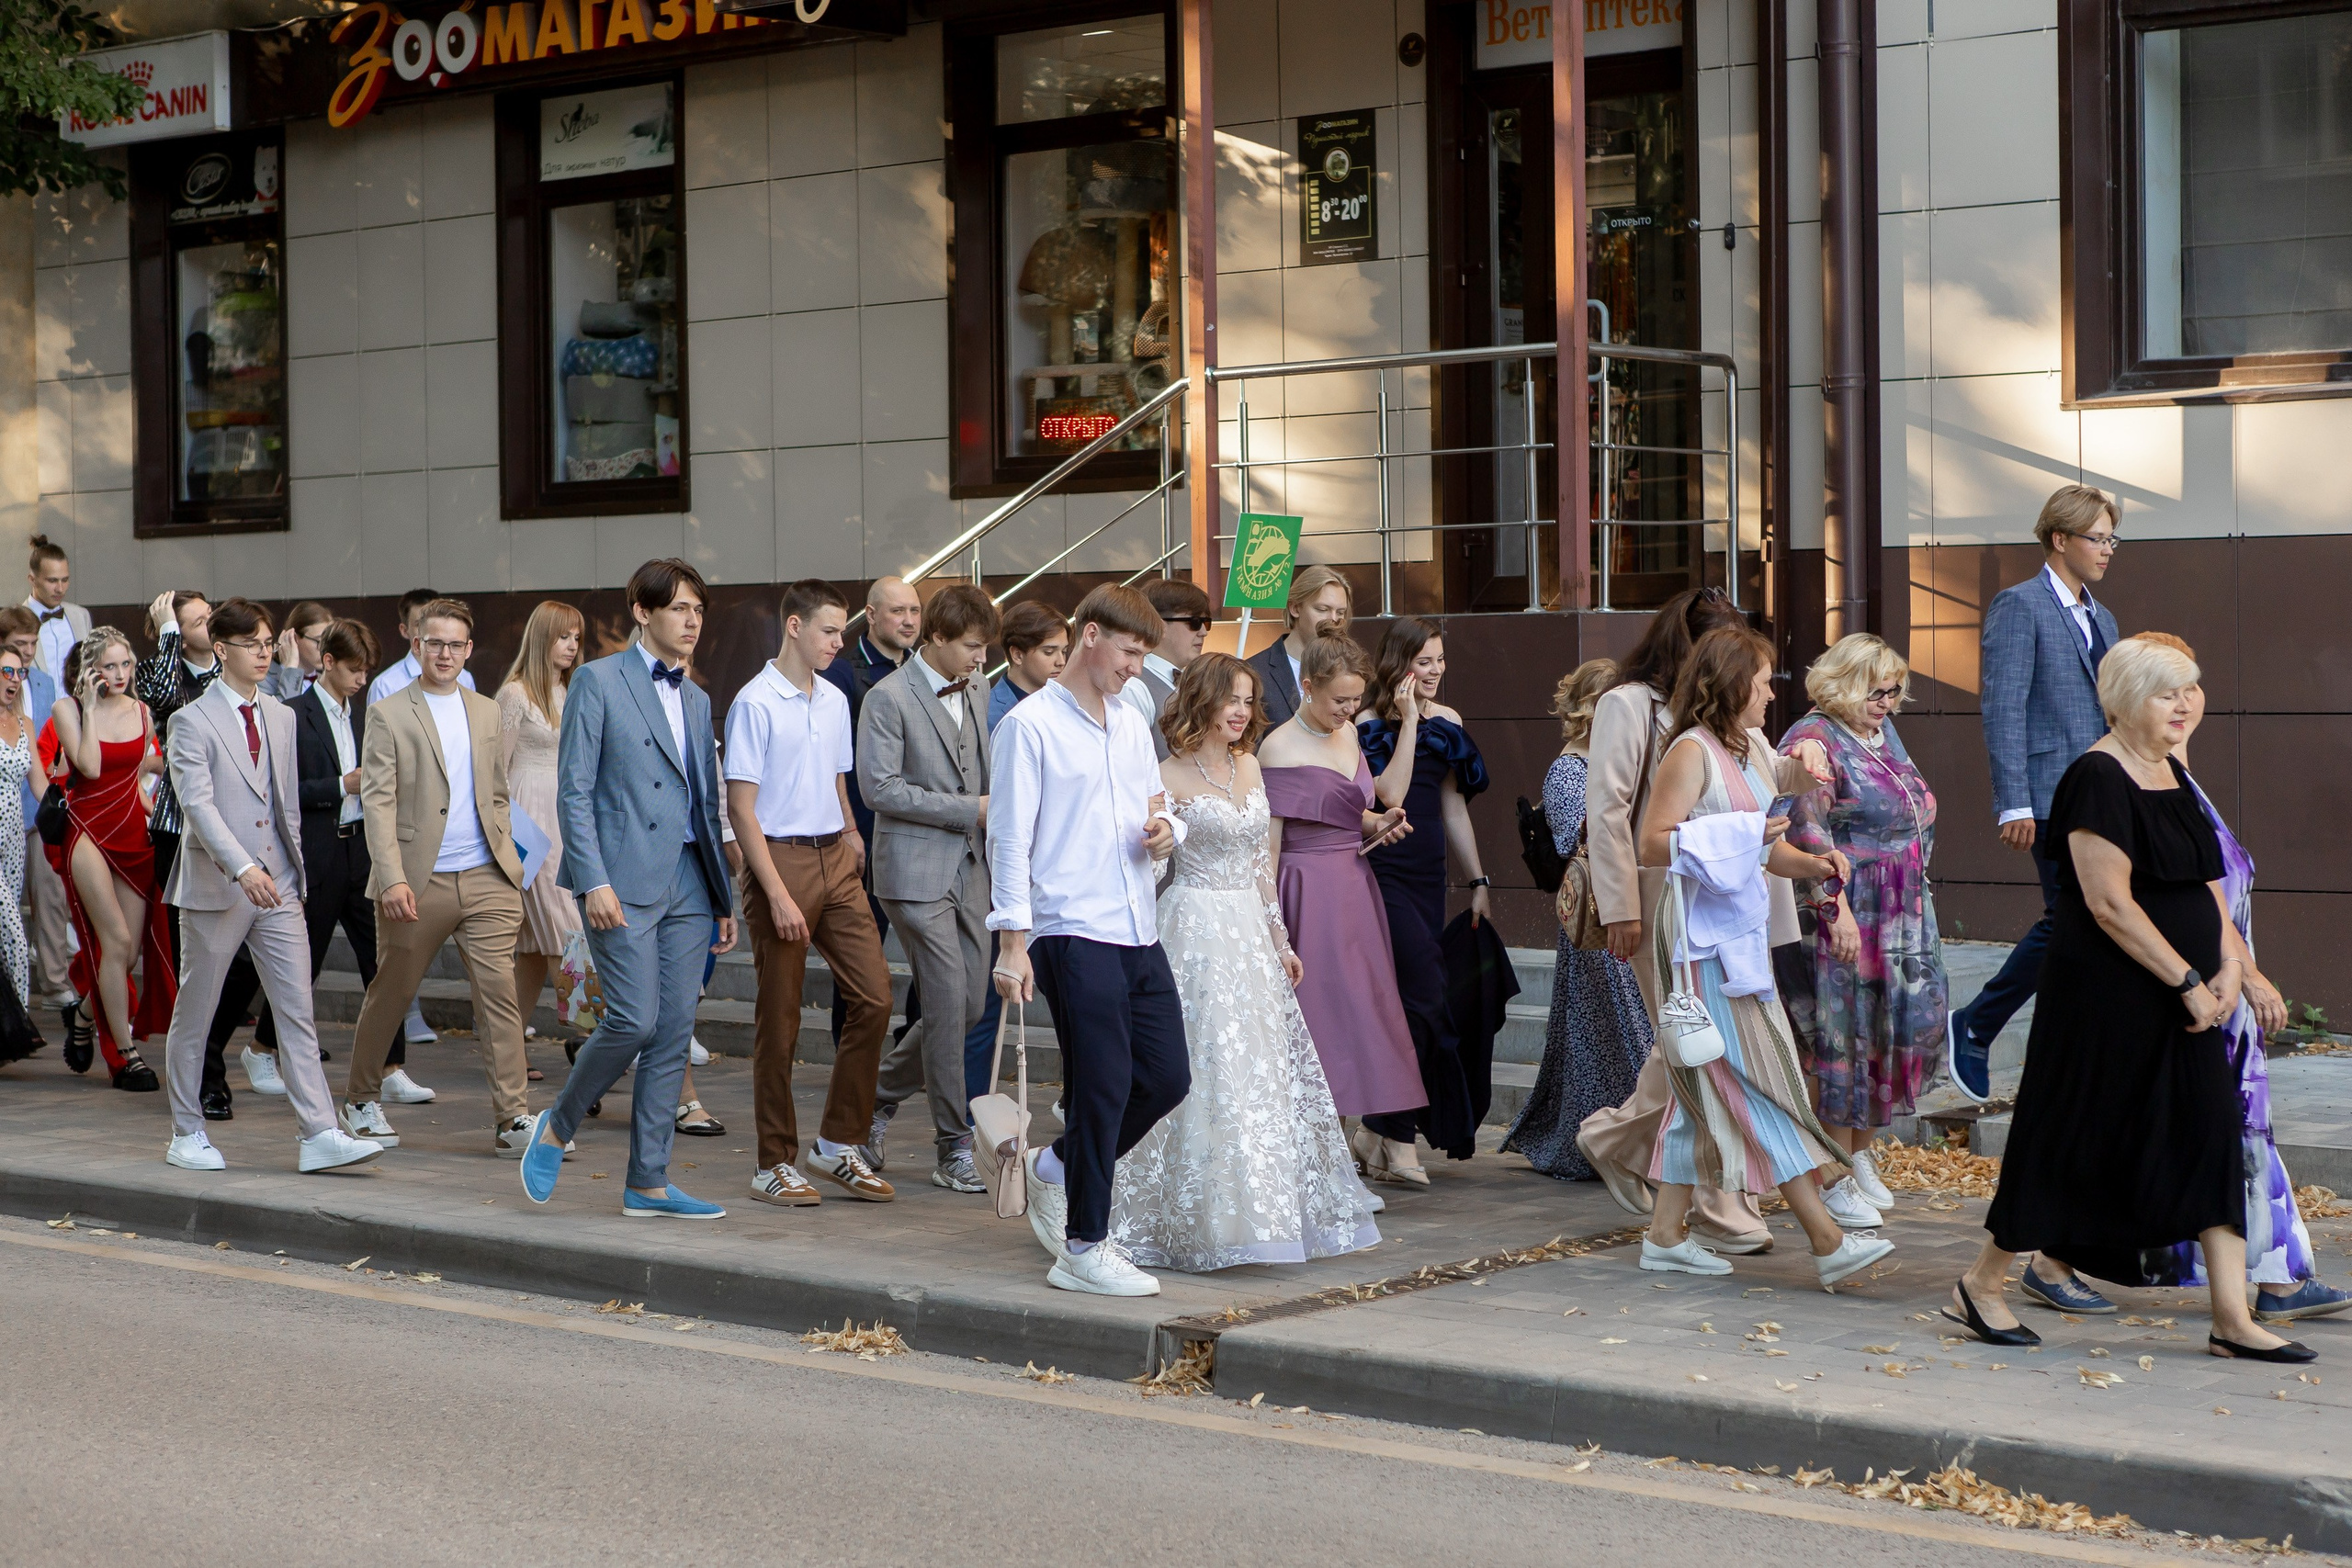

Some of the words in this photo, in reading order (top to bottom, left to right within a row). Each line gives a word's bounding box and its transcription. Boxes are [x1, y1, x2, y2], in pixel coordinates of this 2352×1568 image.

[1486, 0, 1683, 46] Ветптек
[328, 0, 779, 128] ЗООМАГАЗ
[140, 82, 207, 121] CANIN
[555, 111, 600, 144] Sheba
[1611, 216, 1652, 229] ОТКРЫТО
[1041, 416, 1115, 438] ОТКРЫТО
[1236, 564, 1273, 602] ГИМНАЗИЯ
